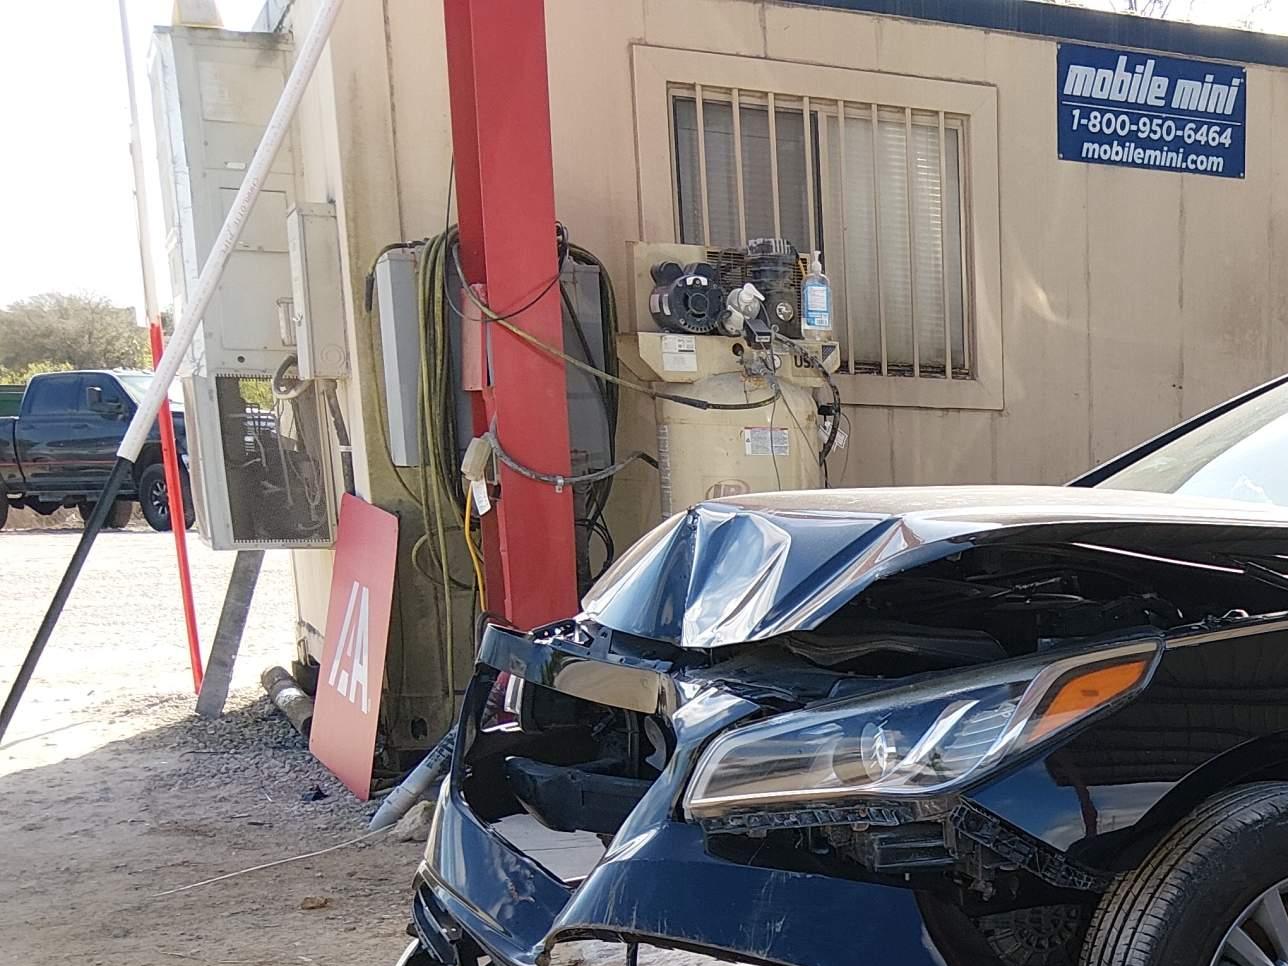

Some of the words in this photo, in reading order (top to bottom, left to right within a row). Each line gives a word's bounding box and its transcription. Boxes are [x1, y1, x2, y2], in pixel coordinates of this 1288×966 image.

[1063, 55, 1169, 107] mobile
[1171, 74, 1241, 115] mini
[1071, 108, 1233, 148] 1-800-950-6464
[1081, 140, 1224, 172] mobilemini.com
